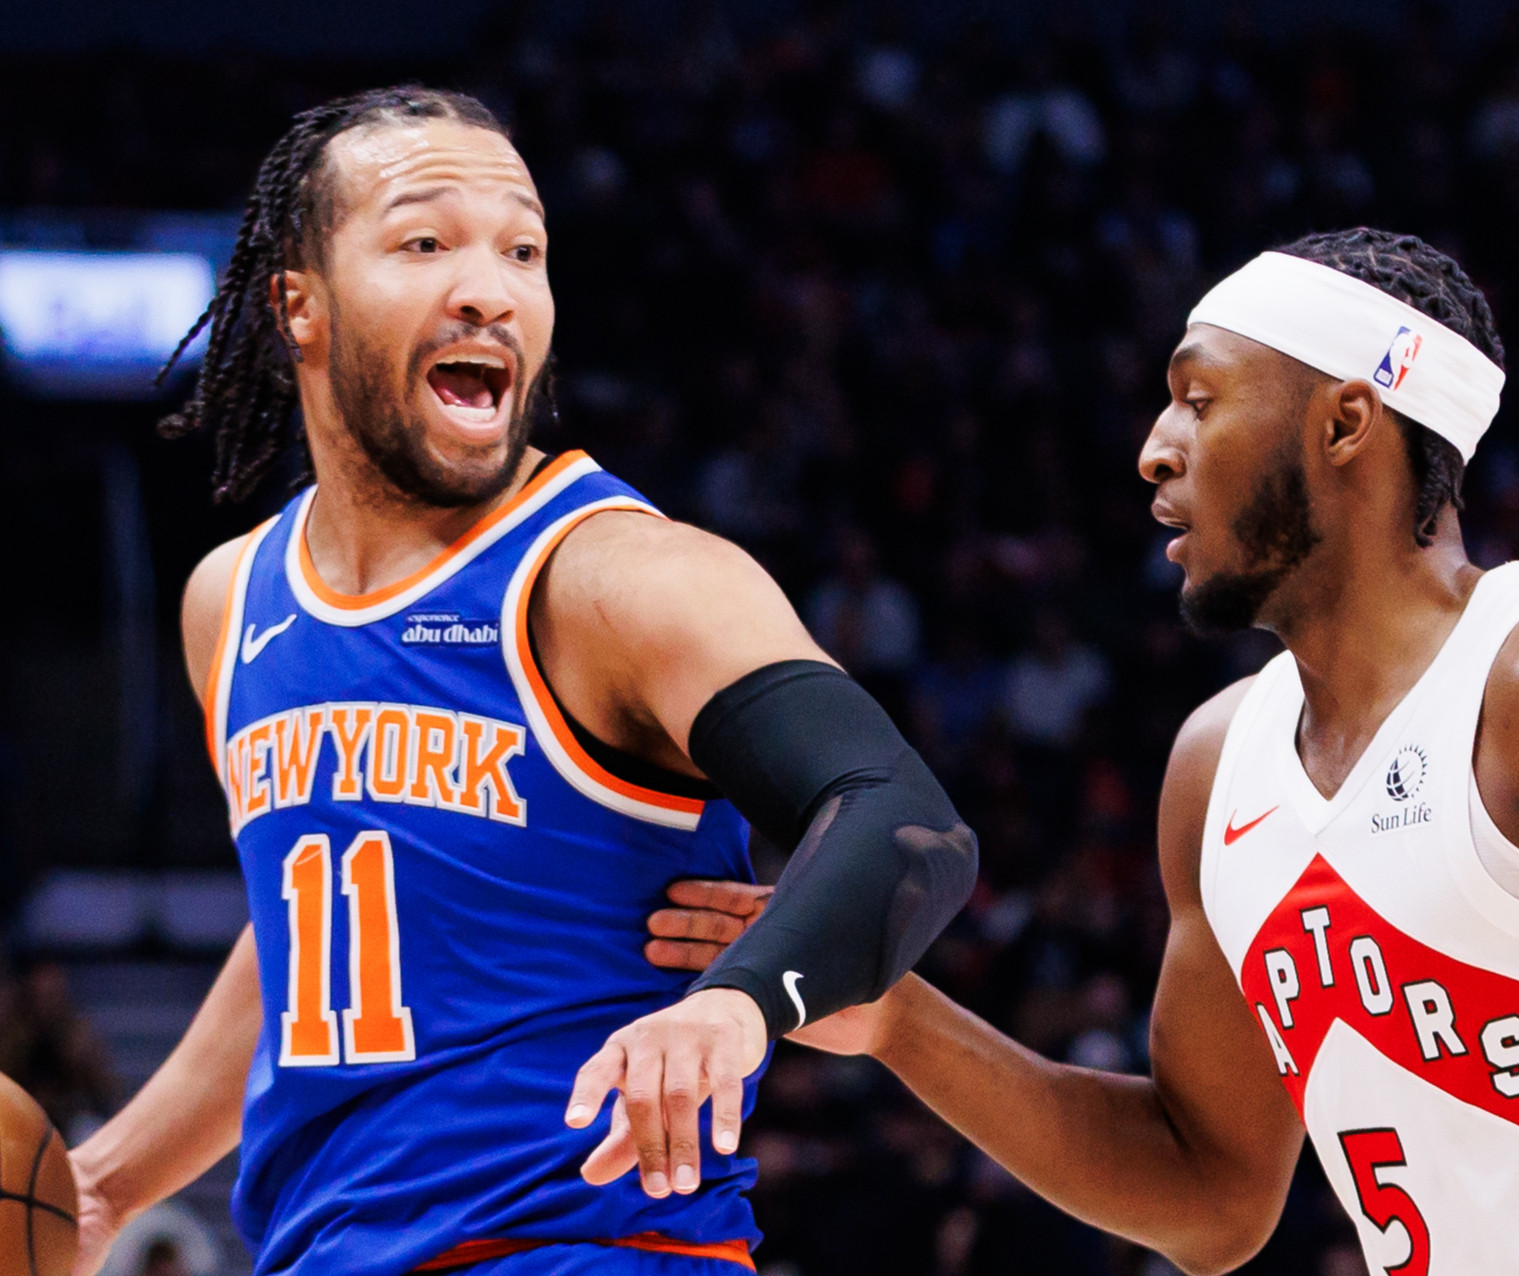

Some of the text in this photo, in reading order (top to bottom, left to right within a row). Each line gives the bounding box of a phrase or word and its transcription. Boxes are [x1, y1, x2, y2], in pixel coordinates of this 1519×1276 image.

[402, 623, 499, 642] abu dhabi
[323, 701, 527, 827] YORK
[1371, 802, 1432, 834] Sun Life
[280, 831, 416, 1066] 11
